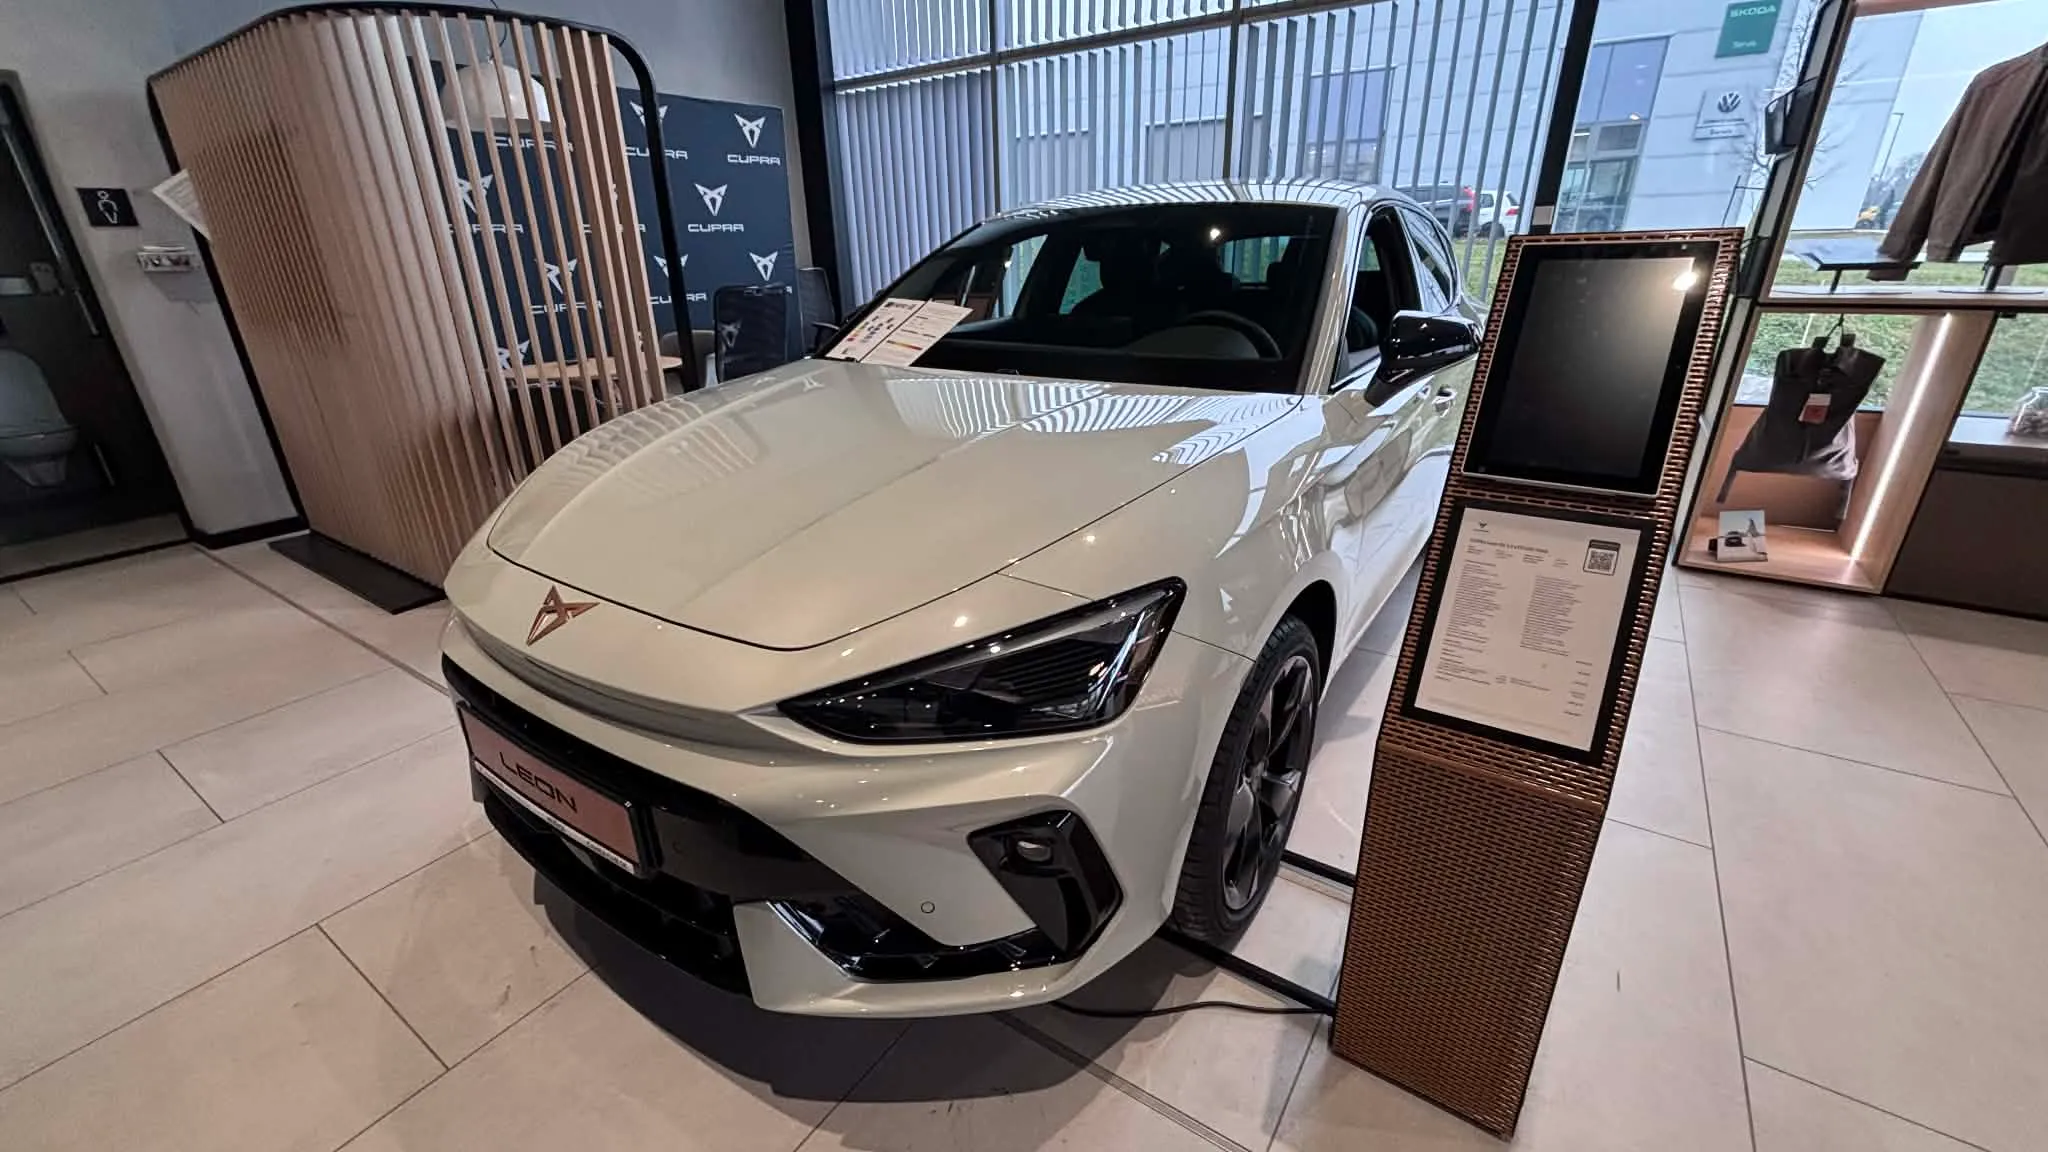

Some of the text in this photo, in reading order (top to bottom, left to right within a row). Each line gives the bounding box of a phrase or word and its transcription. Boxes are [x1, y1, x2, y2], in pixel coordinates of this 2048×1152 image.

[625, 146, 688, 160] CURA
[727, 154, 781, 165] CUPRA
[687, 223, 744, 232] CUPRA
[649, 292, 707, 305] CURA
[499, 751, 578, 813] LEON
